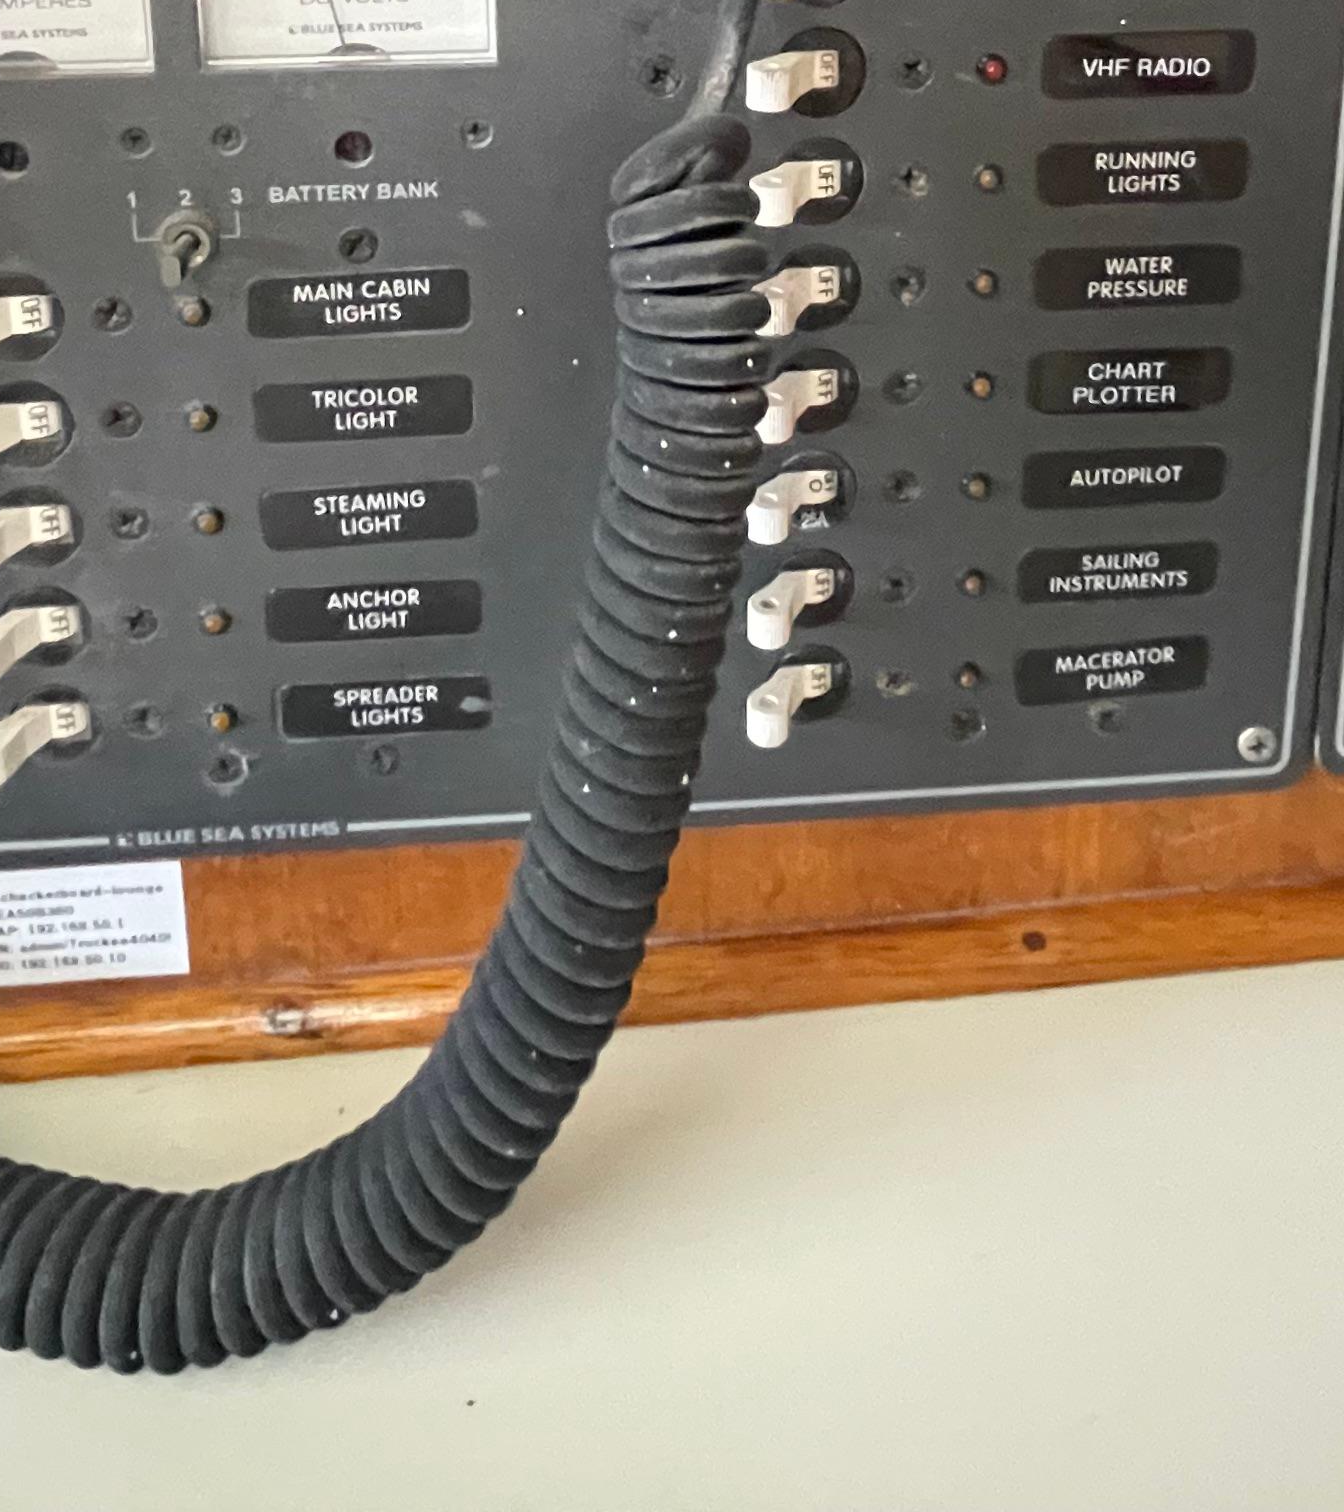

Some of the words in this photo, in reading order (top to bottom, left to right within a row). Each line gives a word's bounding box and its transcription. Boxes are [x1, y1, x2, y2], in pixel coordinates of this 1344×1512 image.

[369, 21, 422, 32] SYSTEMS
[819, 52, 836, 88] OFF
[1083, 59, 1129, 77] VHF
[1138, 58, 1211, 76] RADIO
[1096, 151, 1196, 170] RUNNING
[817, 163, 835, 198] OFF
[1108, 174, 1180, 193] LIGHTS
[179, 189, 192, 206] 2
[231, 188, 243, 204] 3
[269, 184, 369, 203] BATTERY
[377, 182, 438, 199] BANK
[1106, 256, 1172, 275] WATER
[294, 283, 352, 302] MAIN
[361, 278, 429, 298] CABIN
[1088, 278, 1187, 298] PRESSURE
[20, 297, 42, 329] OFF
[325, 303, 401, 324] LIGHTS
[1088, 362, 1165, 381] CHART
[312, 387, 418, 408] TRICOLOR
[1073, 385, 1175, 404] PLOTTER
[27, 404, 50, 438] OFF
[335, 410, 396, 430] LIGHT
[1071, 465, 1182, 486] AUTOPILOT
[314, 490, 425, 515] STEAMING
[341, 514, 401, 536] LIGHT
[1082, 552, 1159, 571] SAILING
[1050, 571, 1187, 592] INSTRUMENTS
[327, 588, 419, 609] ANCHOR
[348, 610, 408, 630] LIGHT
[1056, 646, 1174, 674] MACERATOR
[1086, 670, 1144, 690] PUMP
[334, 685, 438, 706] SPREADER
[352, 707, 423, 727] LIGHTS
[138, 827, 196, 846] BLUE
[200, 825, 244, 843] SEA
[251, 820, 339, 841] SYSTEMS
